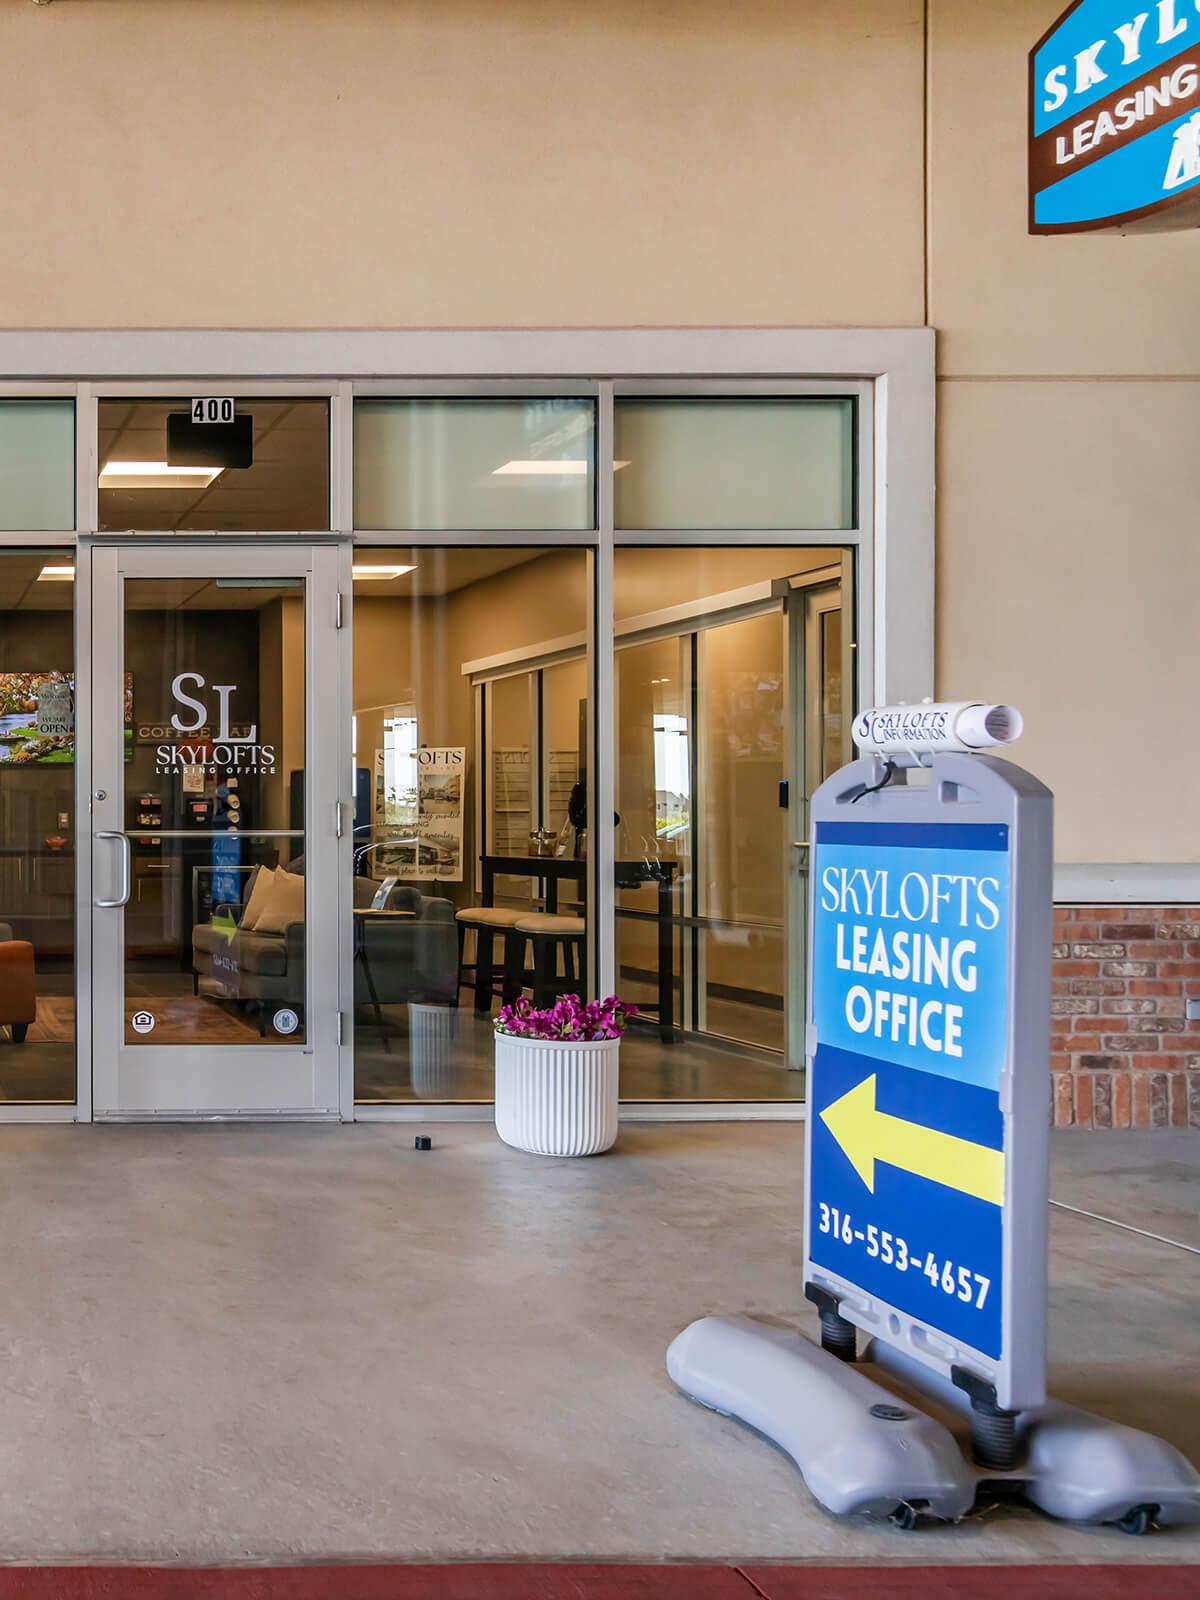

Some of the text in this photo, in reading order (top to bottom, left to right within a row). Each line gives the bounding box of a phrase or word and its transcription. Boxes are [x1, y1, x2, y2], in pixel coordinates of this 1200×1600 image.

[1043, 0, 1200, 112] SKYL
[1056, 63, 1199, 165] LEASING
[193, 399, 232, 422] 400
[39, 723, 69, 734] OPEN
[878, 711, 949, 728] SKYLOFTS
[155, 767, 277, 775] LEASING OFFICE
[156, 745, 275, 765] SKYLOFTS
[821, 866, 1000, 930] SKYLOFTS
[836, 923, 977, 992] LEASING
[845, 985, 963, 1058] OFFICE
[819, 1202, 990, 1310] 316-553-4657
